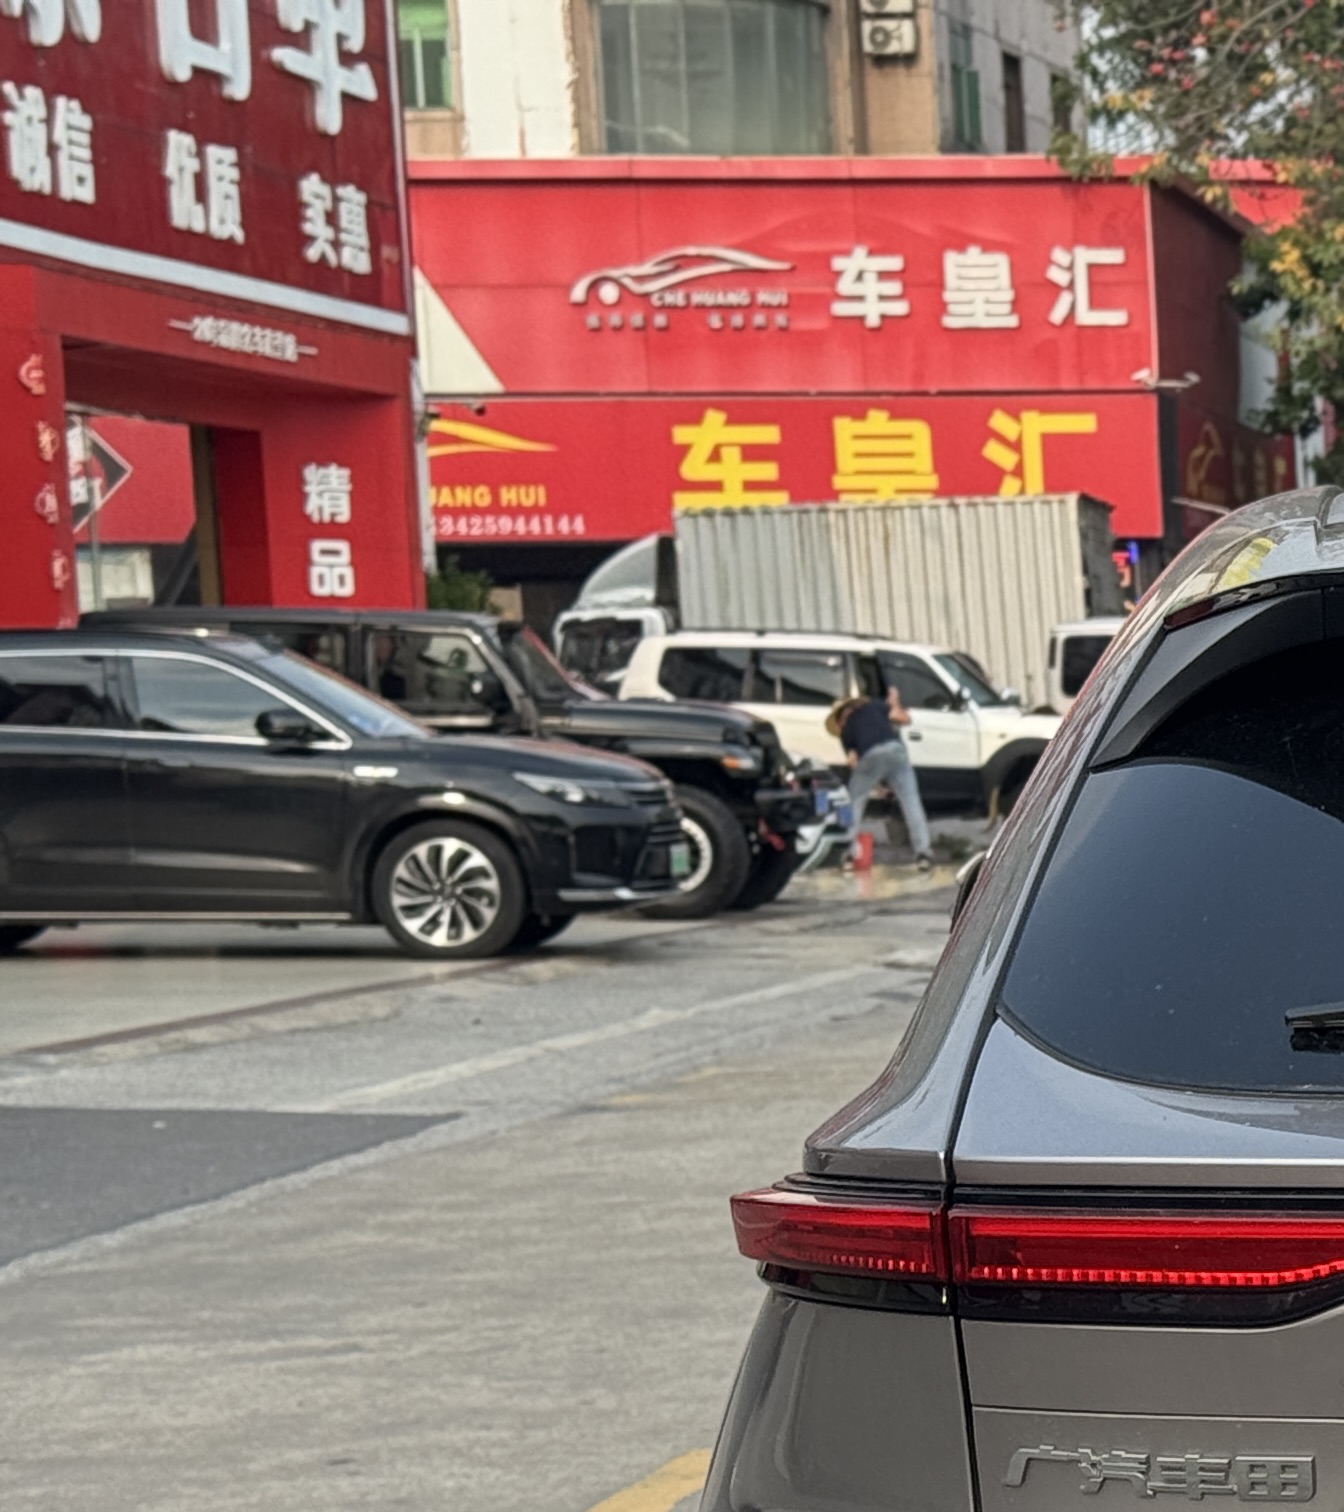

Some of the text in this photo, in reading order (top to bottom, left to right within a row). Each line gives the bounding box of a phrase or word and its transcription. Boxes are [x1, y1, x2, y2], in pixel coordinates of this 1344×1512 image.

[2, 80, 372, 275] 诚信 优质 实惠
[757, 291, 788, 307] HUI
[831, 245, 1129, 328] 车皇汇
[500, 485, 546, 507] HUI
[672, 407, 1098, 516] 车皇汇
[303, 462, 356, 597] 精品
[1003, 1444, 1317, 1502] 广汽丰田
